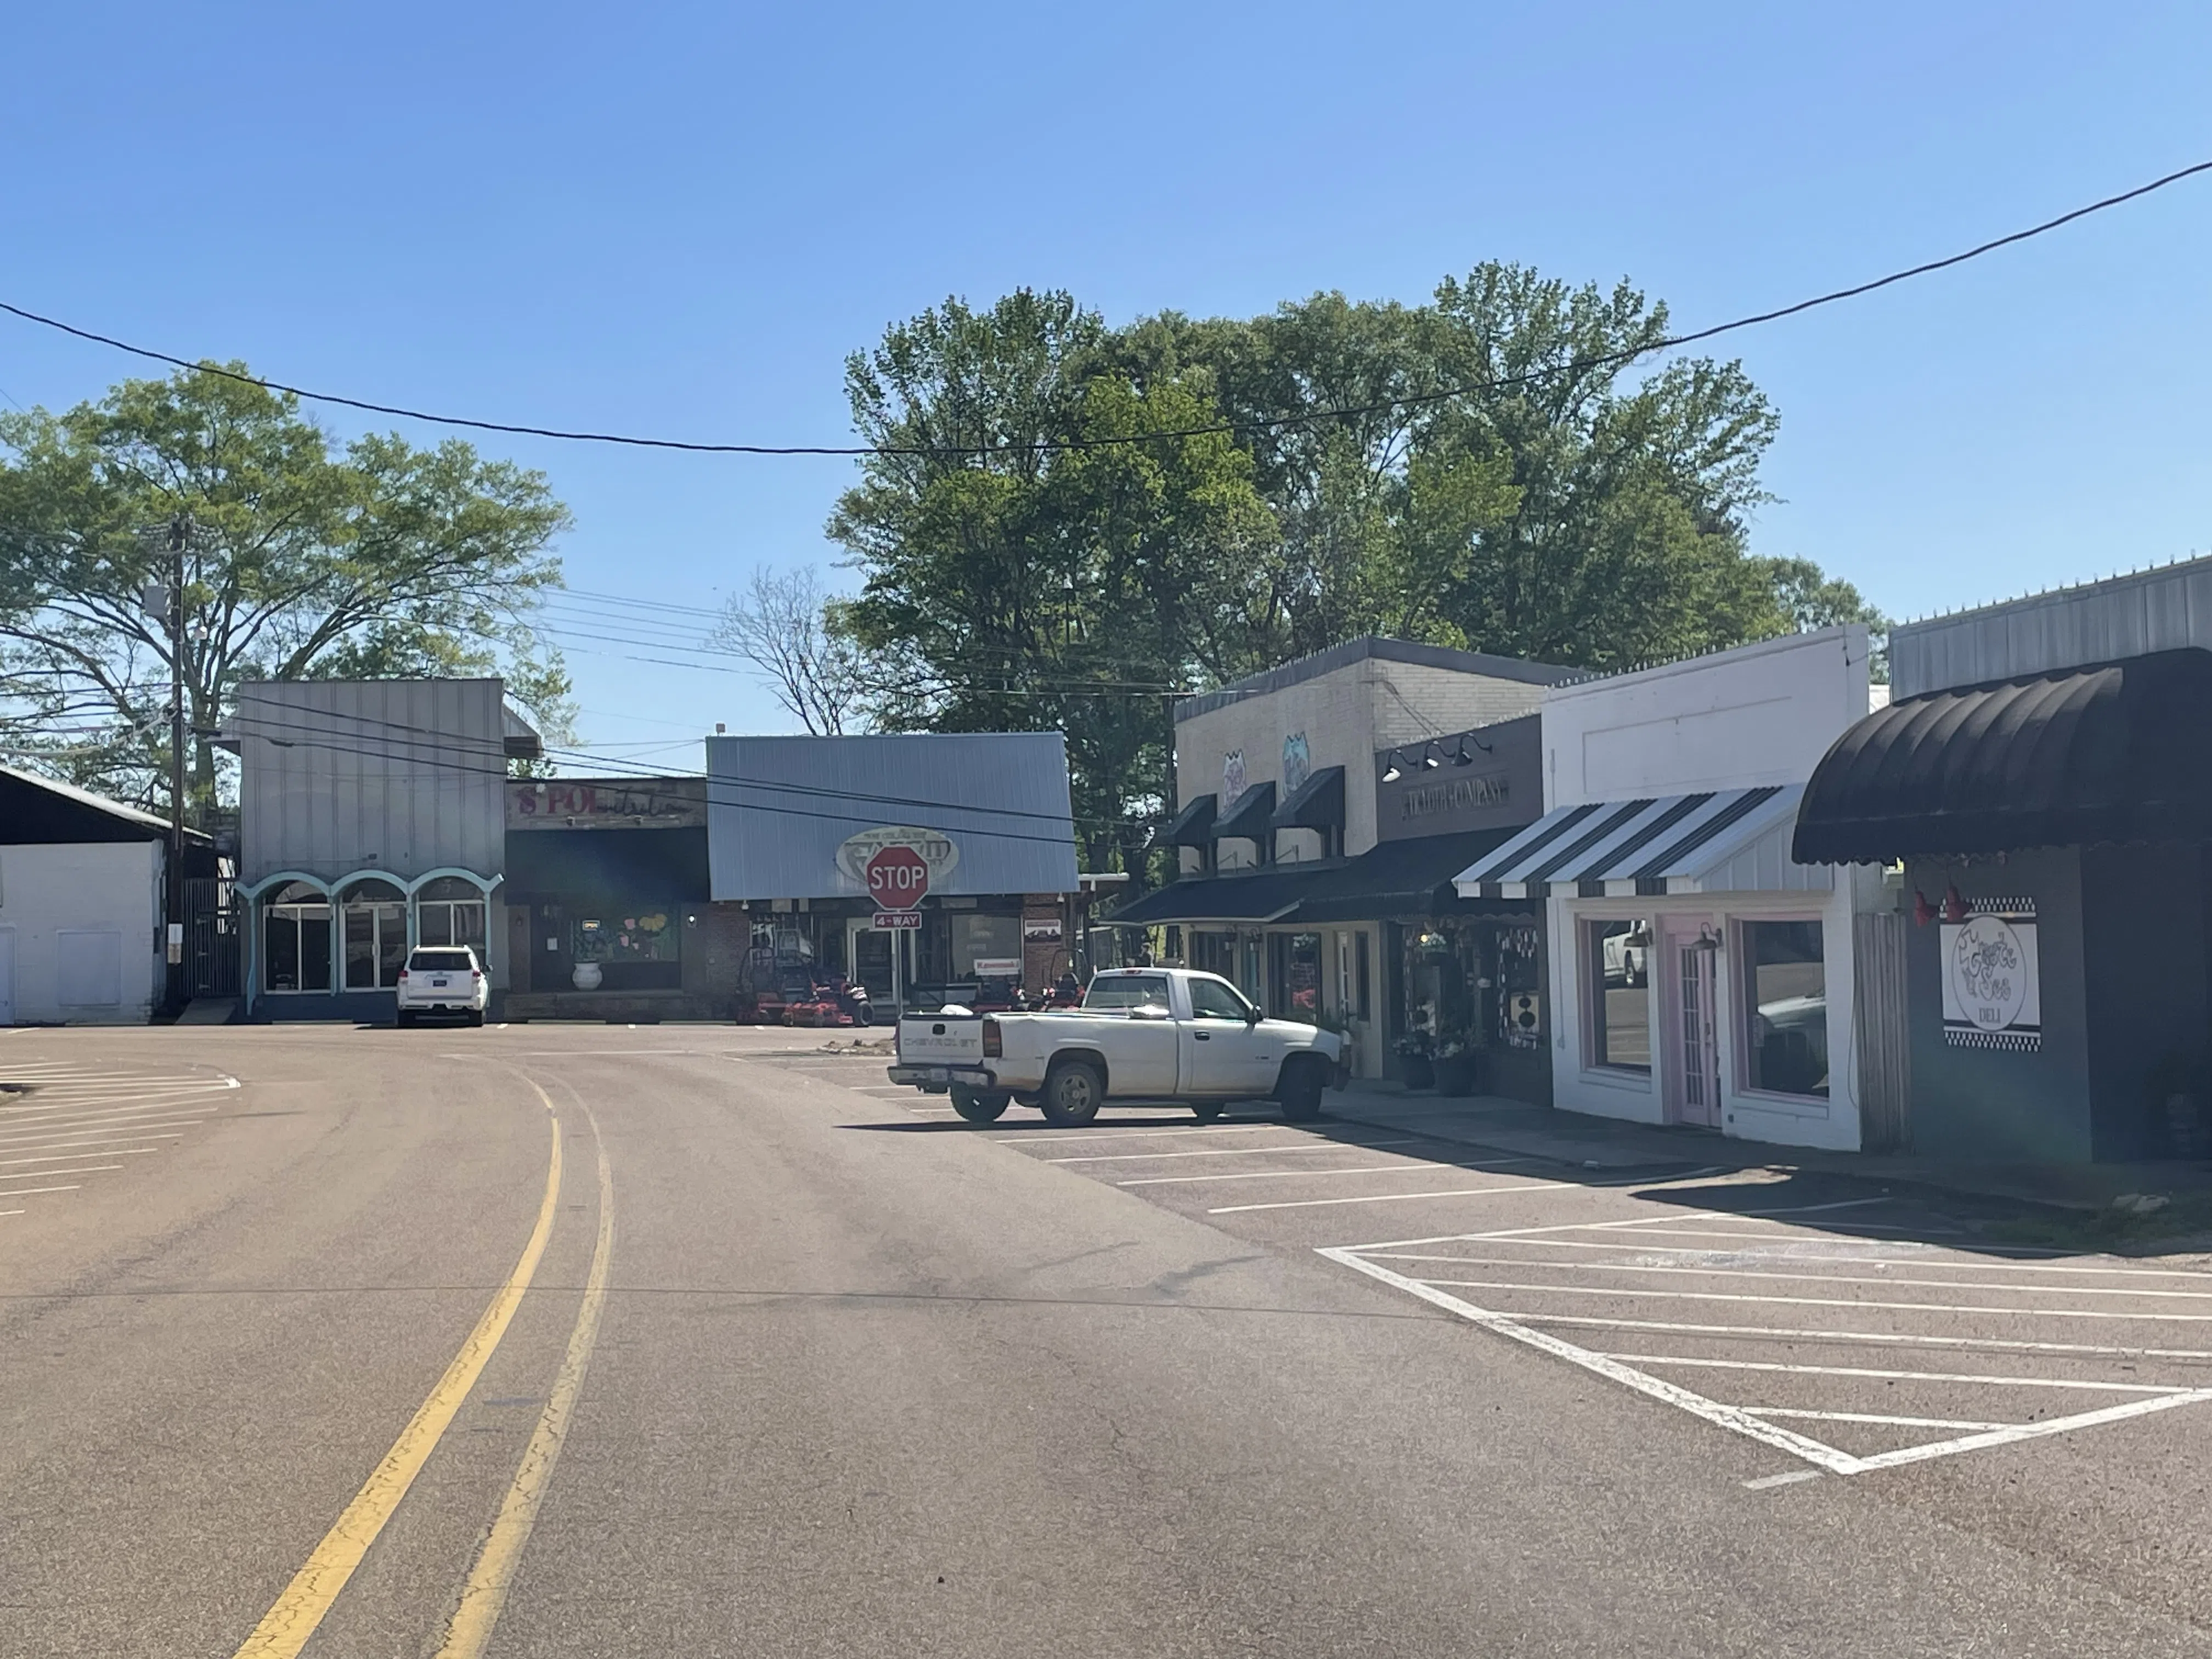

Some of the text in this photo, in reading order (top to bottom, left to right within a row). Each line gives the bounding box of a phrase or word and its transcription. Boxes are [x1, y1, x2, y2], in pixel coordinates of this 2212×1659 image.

[871, 866, 924, 890] STOP
[877, 916, 918, 926] 4-WAY
[1979, 1008, 2001, 1024] DELI
